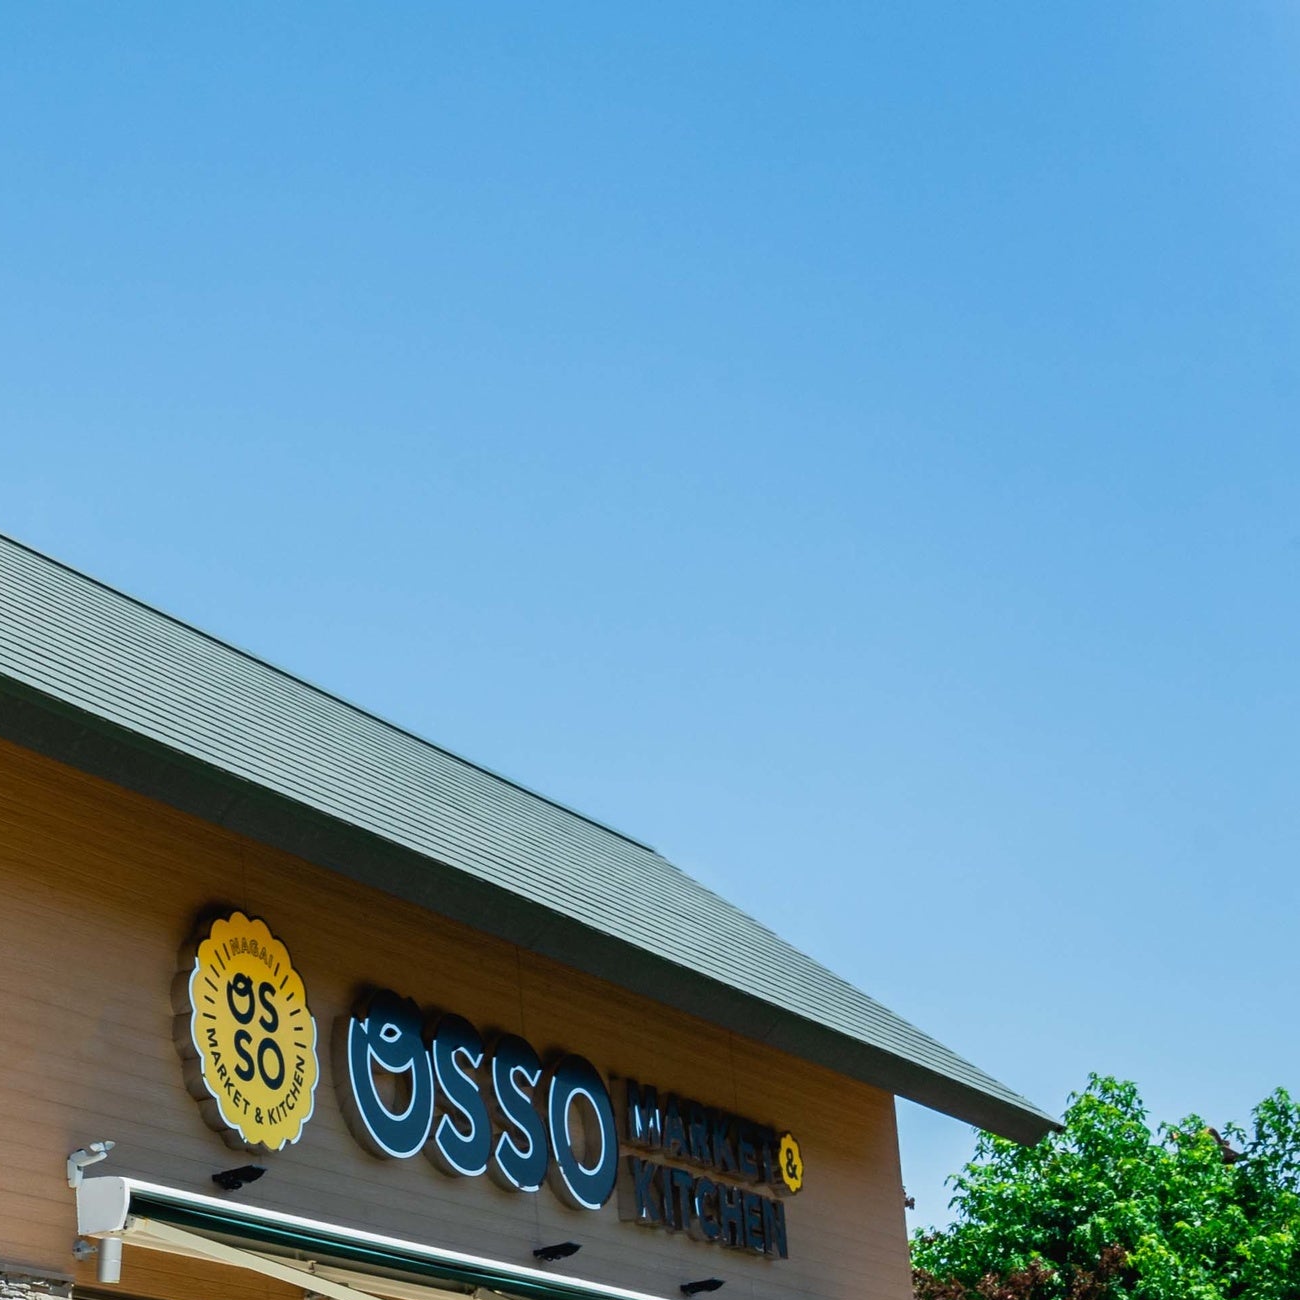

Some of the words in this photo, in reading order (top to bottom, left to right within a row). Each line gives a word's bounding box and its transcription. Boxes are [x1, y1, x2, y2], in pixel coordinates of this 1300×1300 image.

[230, 937, 273, 968] NAGAI
[206, 1028, 251, 1115] MARKET
[255, 1107, 264, 1125] &
[268, 1054, 305, 1126] KITCHEN
[234, 1029, 285, 1090] SO
[627, 1078, 775, 1184] MARKET
[785, 1148, 798, 1180] &
[633, 1156, 788, 1259] KITCHEN
